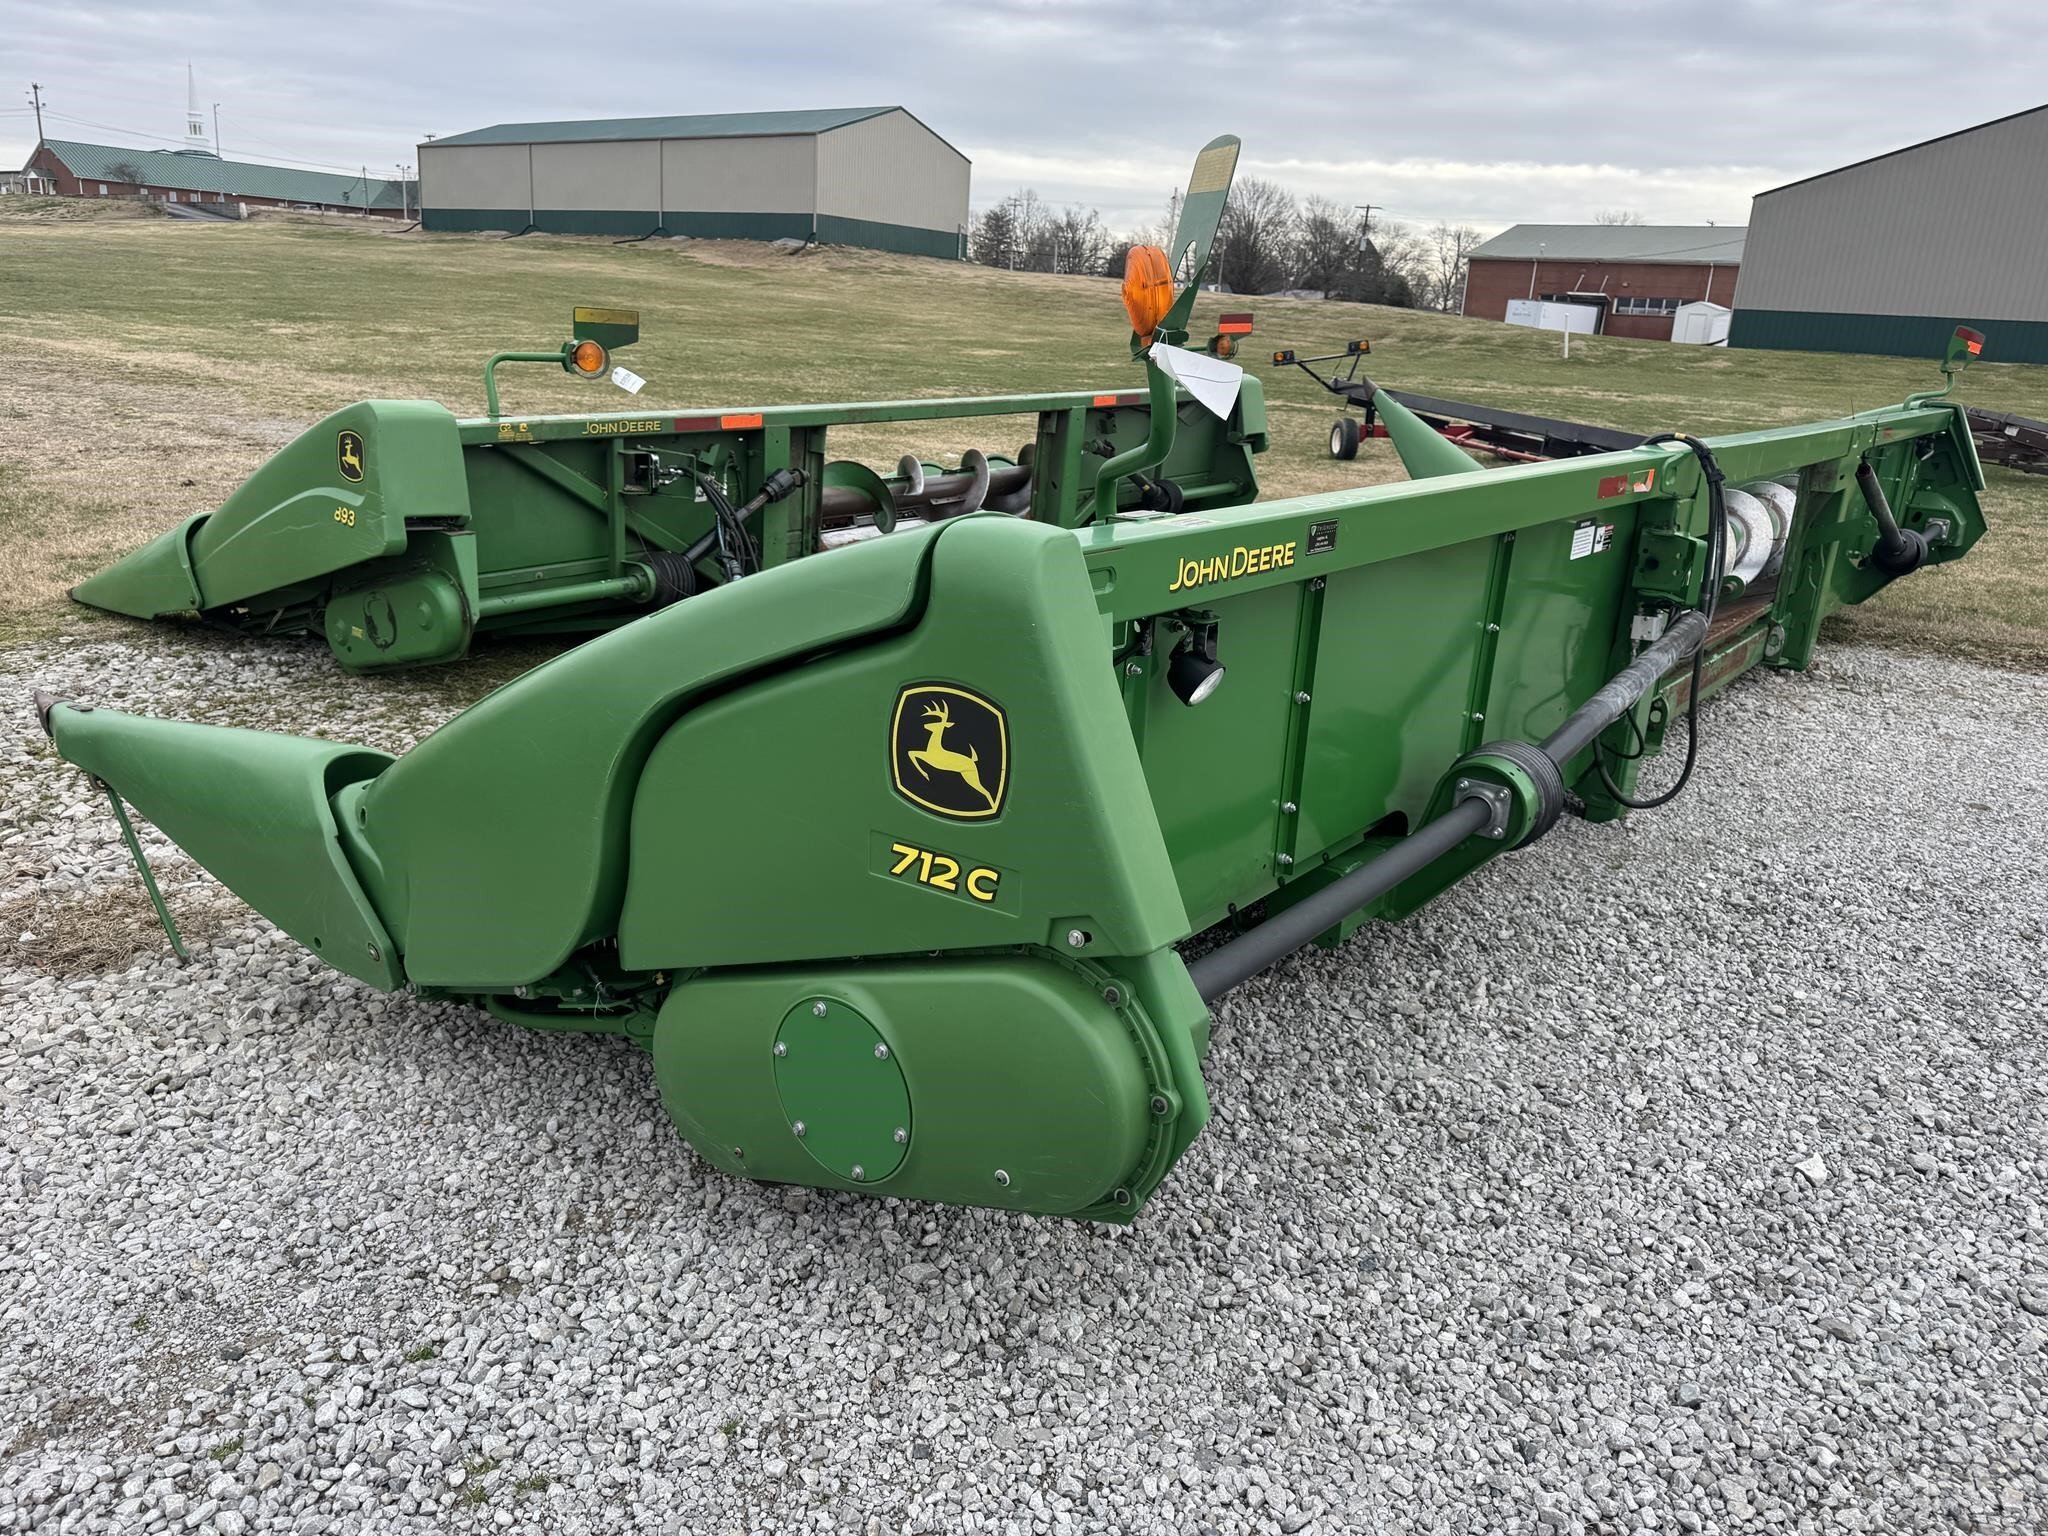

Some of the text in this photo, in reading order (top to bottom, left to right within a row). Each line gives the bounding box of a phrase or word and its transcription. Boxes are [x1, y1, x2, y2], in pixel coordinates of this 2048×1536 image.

[582, 420, 662, 435] JOHN DEERE
[1169, 541, 1297, 591] JOHN DEERE
